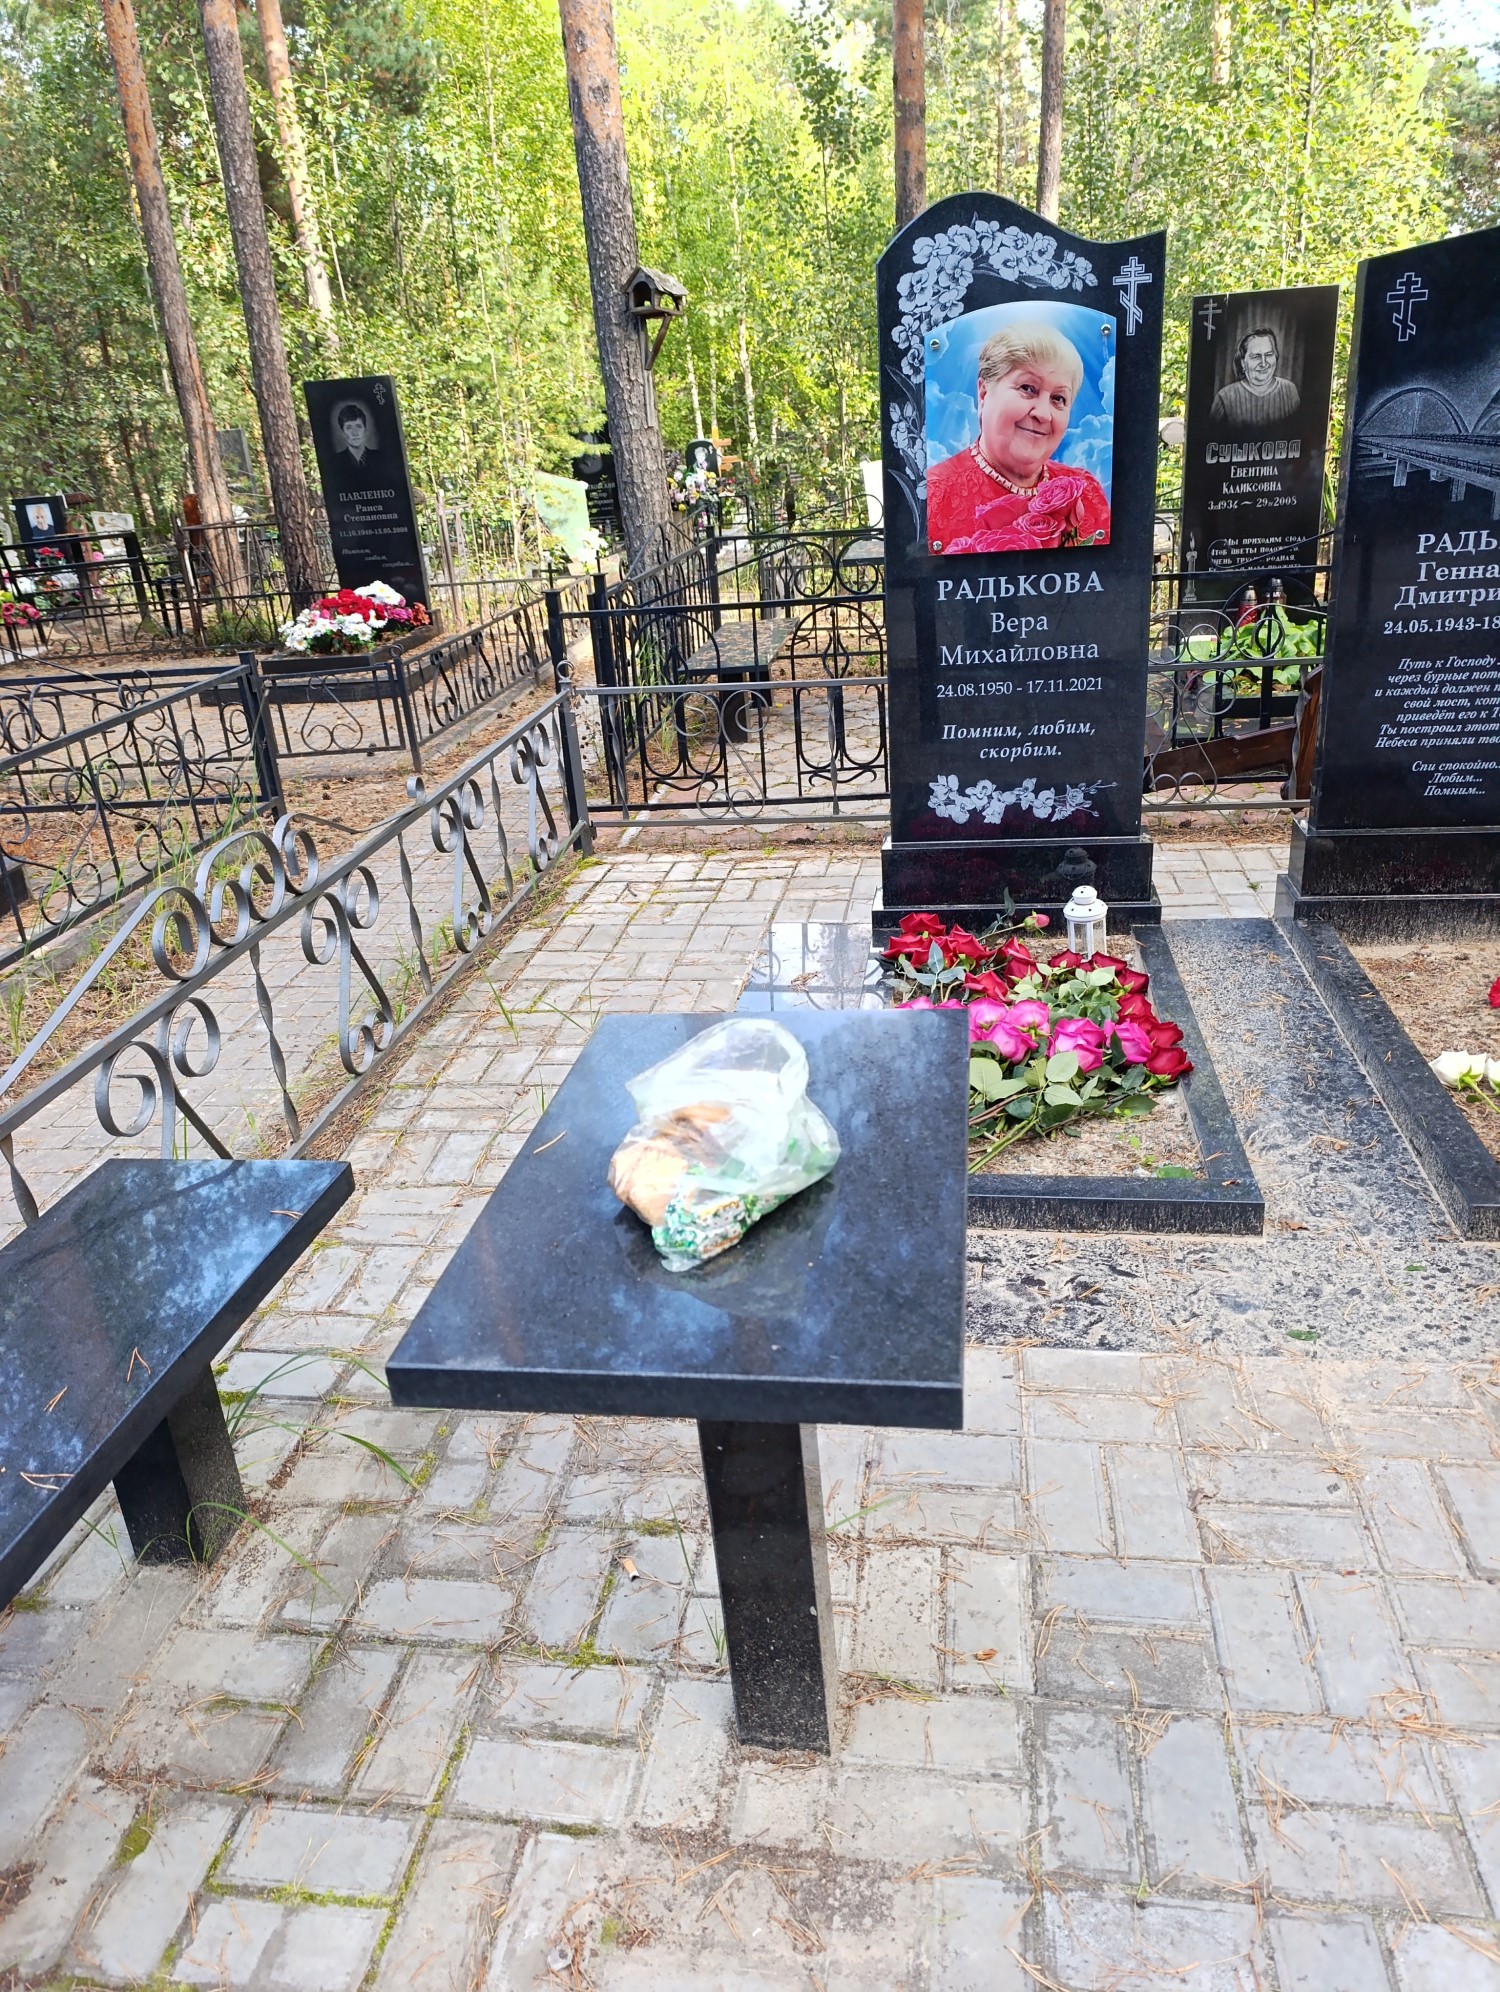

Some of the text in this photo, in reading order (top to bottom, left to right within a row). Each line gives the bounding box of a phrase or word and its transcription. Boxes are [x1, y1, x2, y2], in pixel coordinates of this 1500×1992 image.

[1205, 439, 1301, 464] СУШКОВА
[339, 489, 396, 502] ПАВЛЕНКО
[1416, 530, 1500, 556] РАДЬ
[1417, 561, 1500, 582] Генна
[937, 571, 1104, 603] РАДЬКОВА
[1393, 585, 1500, 611] Дмитри
[990, 612, 1049, 639] Вера
[940, 643, 1100, 666] Михайловна
[1397, 654, 1497, 672] Путь к Господу
[1387, 673, 1421, 685] через
[1423, 671, 1470, 684] бурные
[936, 681, 1013, 698] 24.08.1950
[1027, 677, 1103, 694] 17.11.2021
[1374, 689, 1383, 697] и
[1385, 684, 1440, 697] каждый
[1441, 683, 1491, 694] должен
[1403, 697, 1431, 709] свой
[1432, 698, 1471, 708] мост,
[1396, 709, 1456, 724] приведёт
[1458, 711, 1478, 720] его
[1479, 710, 1489, 719] к
[941, 719, 1096, 740] Помним, любим,
[1379, 722, 1500, 736] Ты построил этот
[1375, 736, 1418, 748] Небеса
[1420, 737, 1476, 749] приняли
[979, 742, 1063, 762] скорбим.
[1412, 760, 1437, 772] Спи
[1428, 772, 1483, 783] Любим...
[1423, 785, 1486, 796] Помним...
